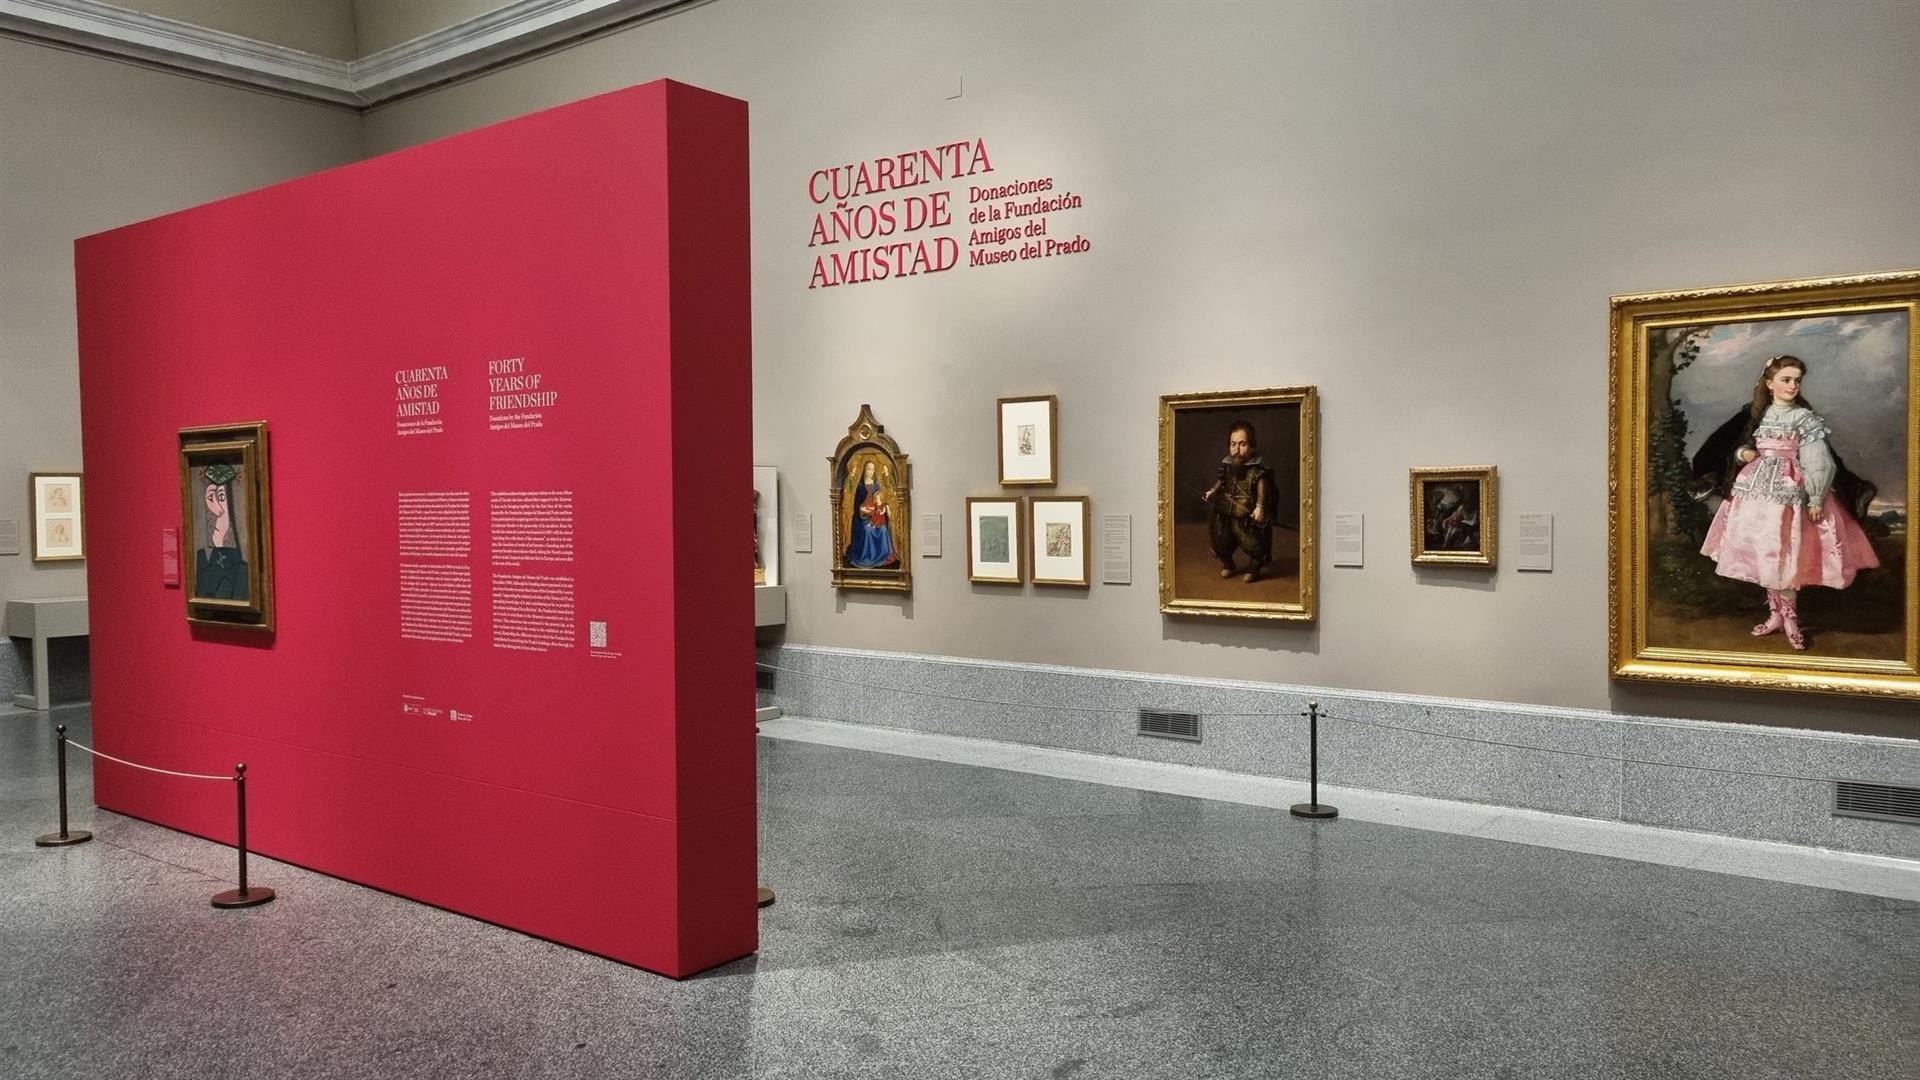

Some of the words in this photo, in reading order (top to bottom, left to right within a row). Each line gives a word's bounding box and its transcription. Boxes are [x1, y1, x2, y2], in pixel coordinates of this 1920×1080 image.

[809, 137, 994, 204] CUARENTA
[969, 177, 1053, 203] Donaciones
[808, 201, 896, 247] AÑOS
[904, 191, 951, 232] DE
[969, 207, 985, 224] de
[988, 204, 1001, 221] la
[1005, 192, 1082, 219] Fundación
[969, 224, 1021, 246] Amigos
[1024, 218, 1046, 237] del
[808, 236, 959, 289] AMISTAD
[969, 249, 1016, 267] Museo
[1020, 243, 1042, 260] del
[1045, 234, 1090, 257] Prado
[395, 366, 448, 384] CUARENTA
[488, 358, 524, 375] FORTY
[396, 383, 422, 400] AÑOS
[423, 384, 438, 398] DE
[488, 377, 524, 393] YEARS
[525, 374, 541, 389] OF
[396, 401, 440, 417] AMISTAD
[489, 391, 558, 410] FRIENDSHIP
